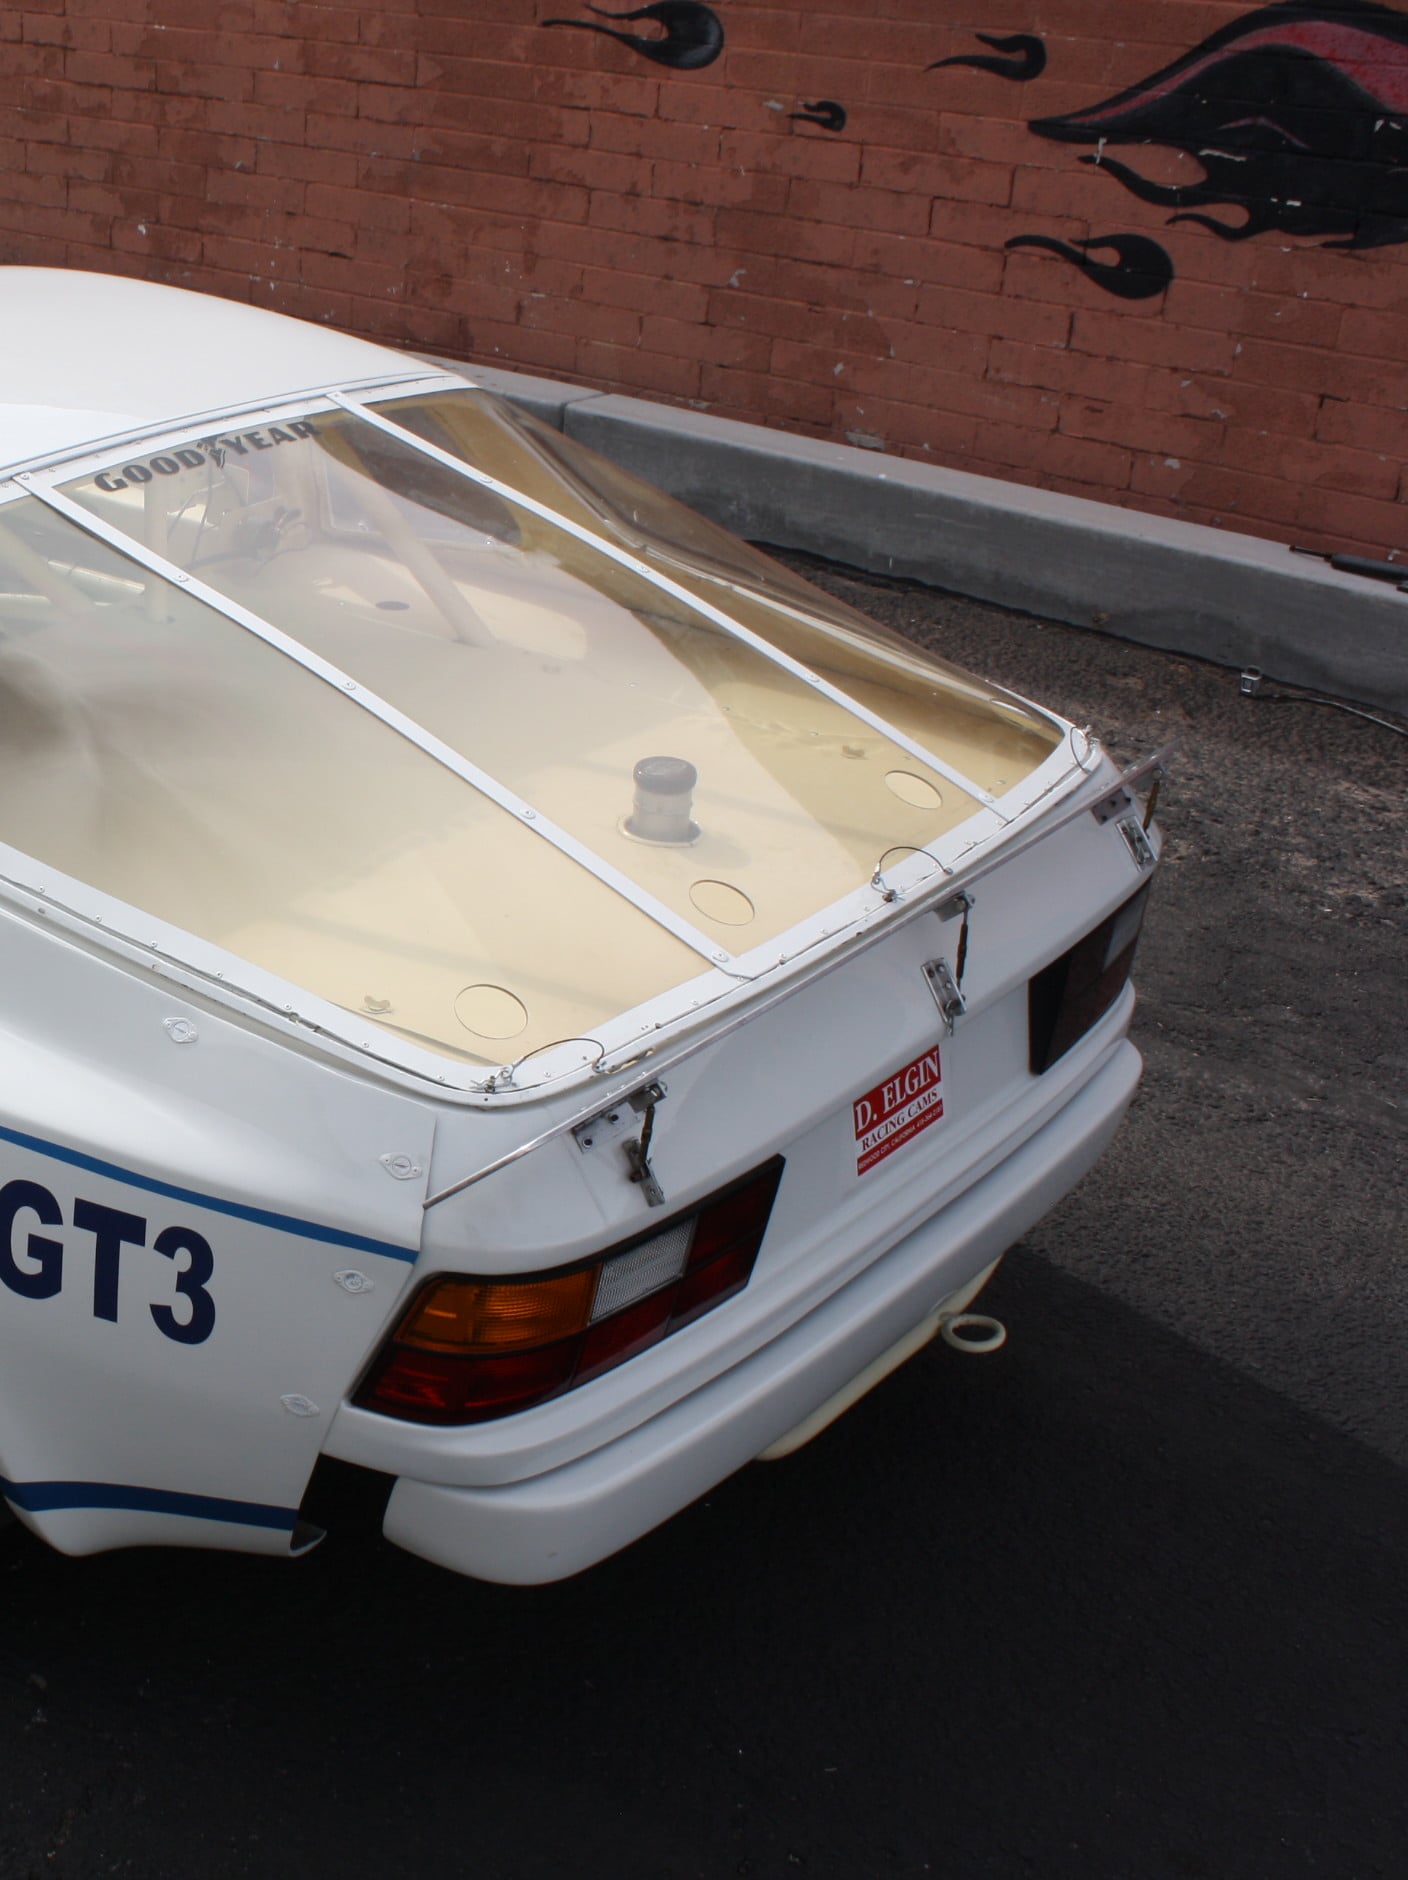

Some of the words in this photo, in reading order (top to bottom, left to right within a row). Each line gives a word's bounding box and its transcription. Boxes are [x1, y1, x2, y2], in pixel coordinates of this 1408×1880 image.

[856, 1100, 878, 1132] D.
[881, 1051, 940, 1114] ELGIN
[861, 1111, 905, 1152] RACING
[907, 1088, 938, 1118] CAMS
